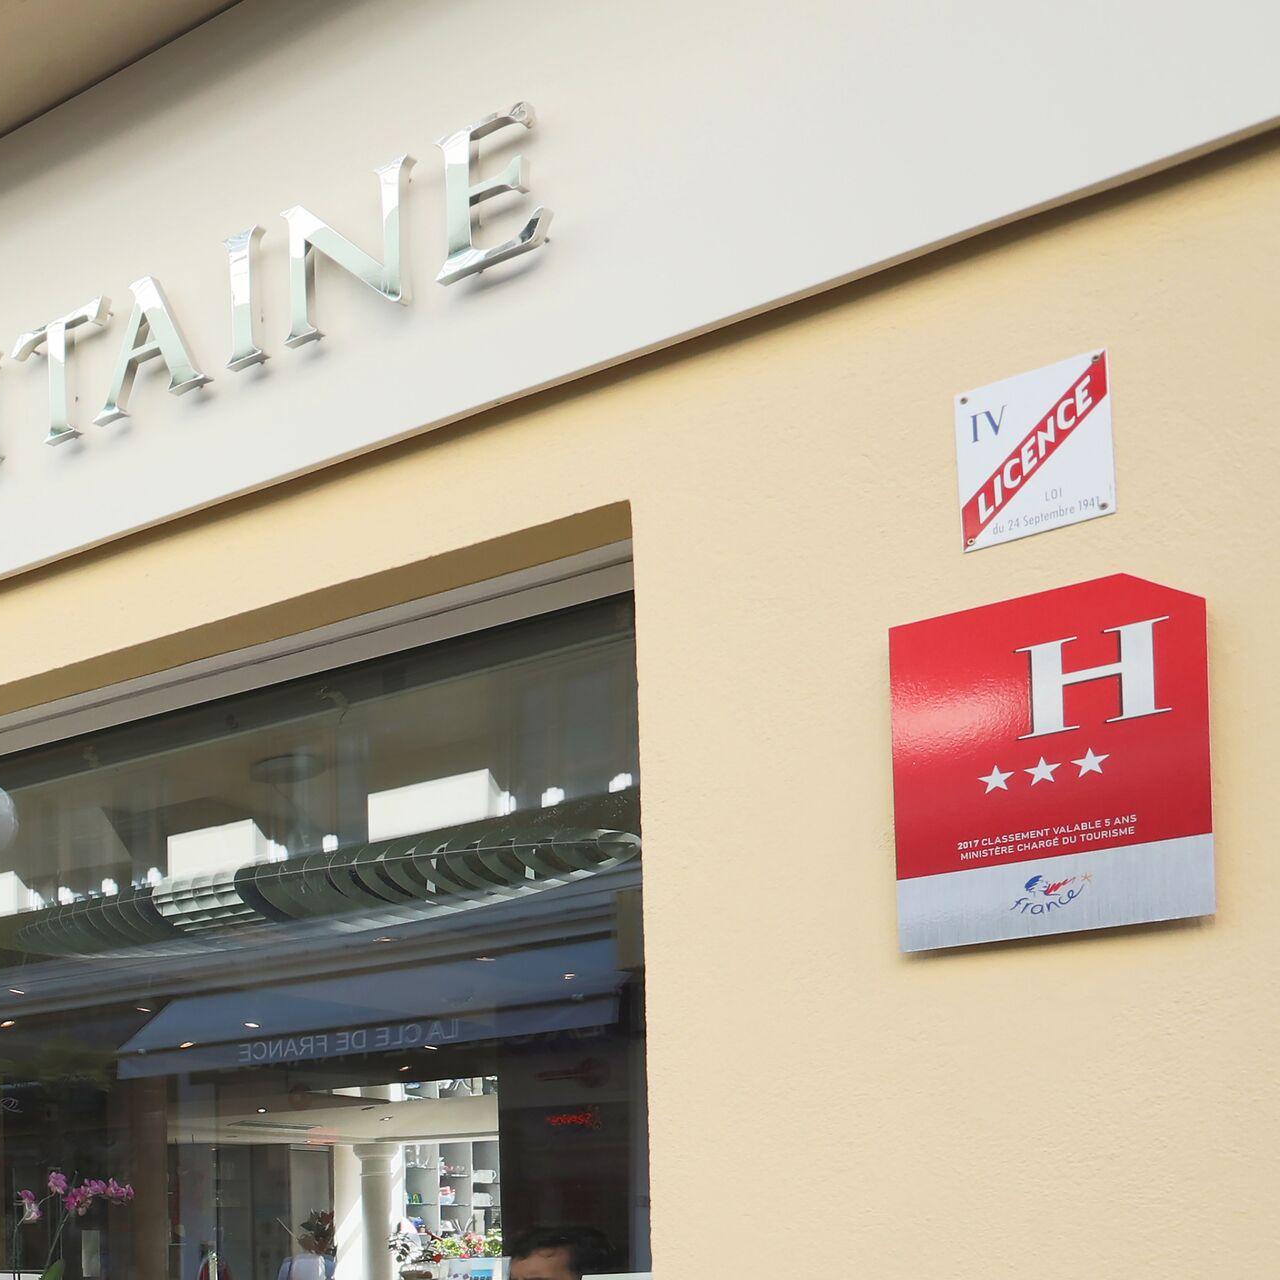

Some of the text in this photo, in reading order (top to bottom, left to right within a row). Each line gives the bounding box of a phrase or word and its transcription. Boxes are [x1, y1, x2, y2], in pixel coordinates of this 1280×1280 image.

[970, 404, 1007, 443] IV
[977, 375, 1092, 525] LICENCE
[1045, 487, 1063, 502] LOI
[992, 523, 1005, 535] du
[1008, 518, 1020, 531] 24
[1023, 503, 1075, 528] Septembre
[1014, 614, 1173, 741] H
[957, 814, 1137, 850] 2017 CLASSEMENT VALABLE 5 ANS
[960, 826, 1135, 861] MINISTÈRE CHARGÉ DU TOURISME
[1010, 884, 1085, 915] france
